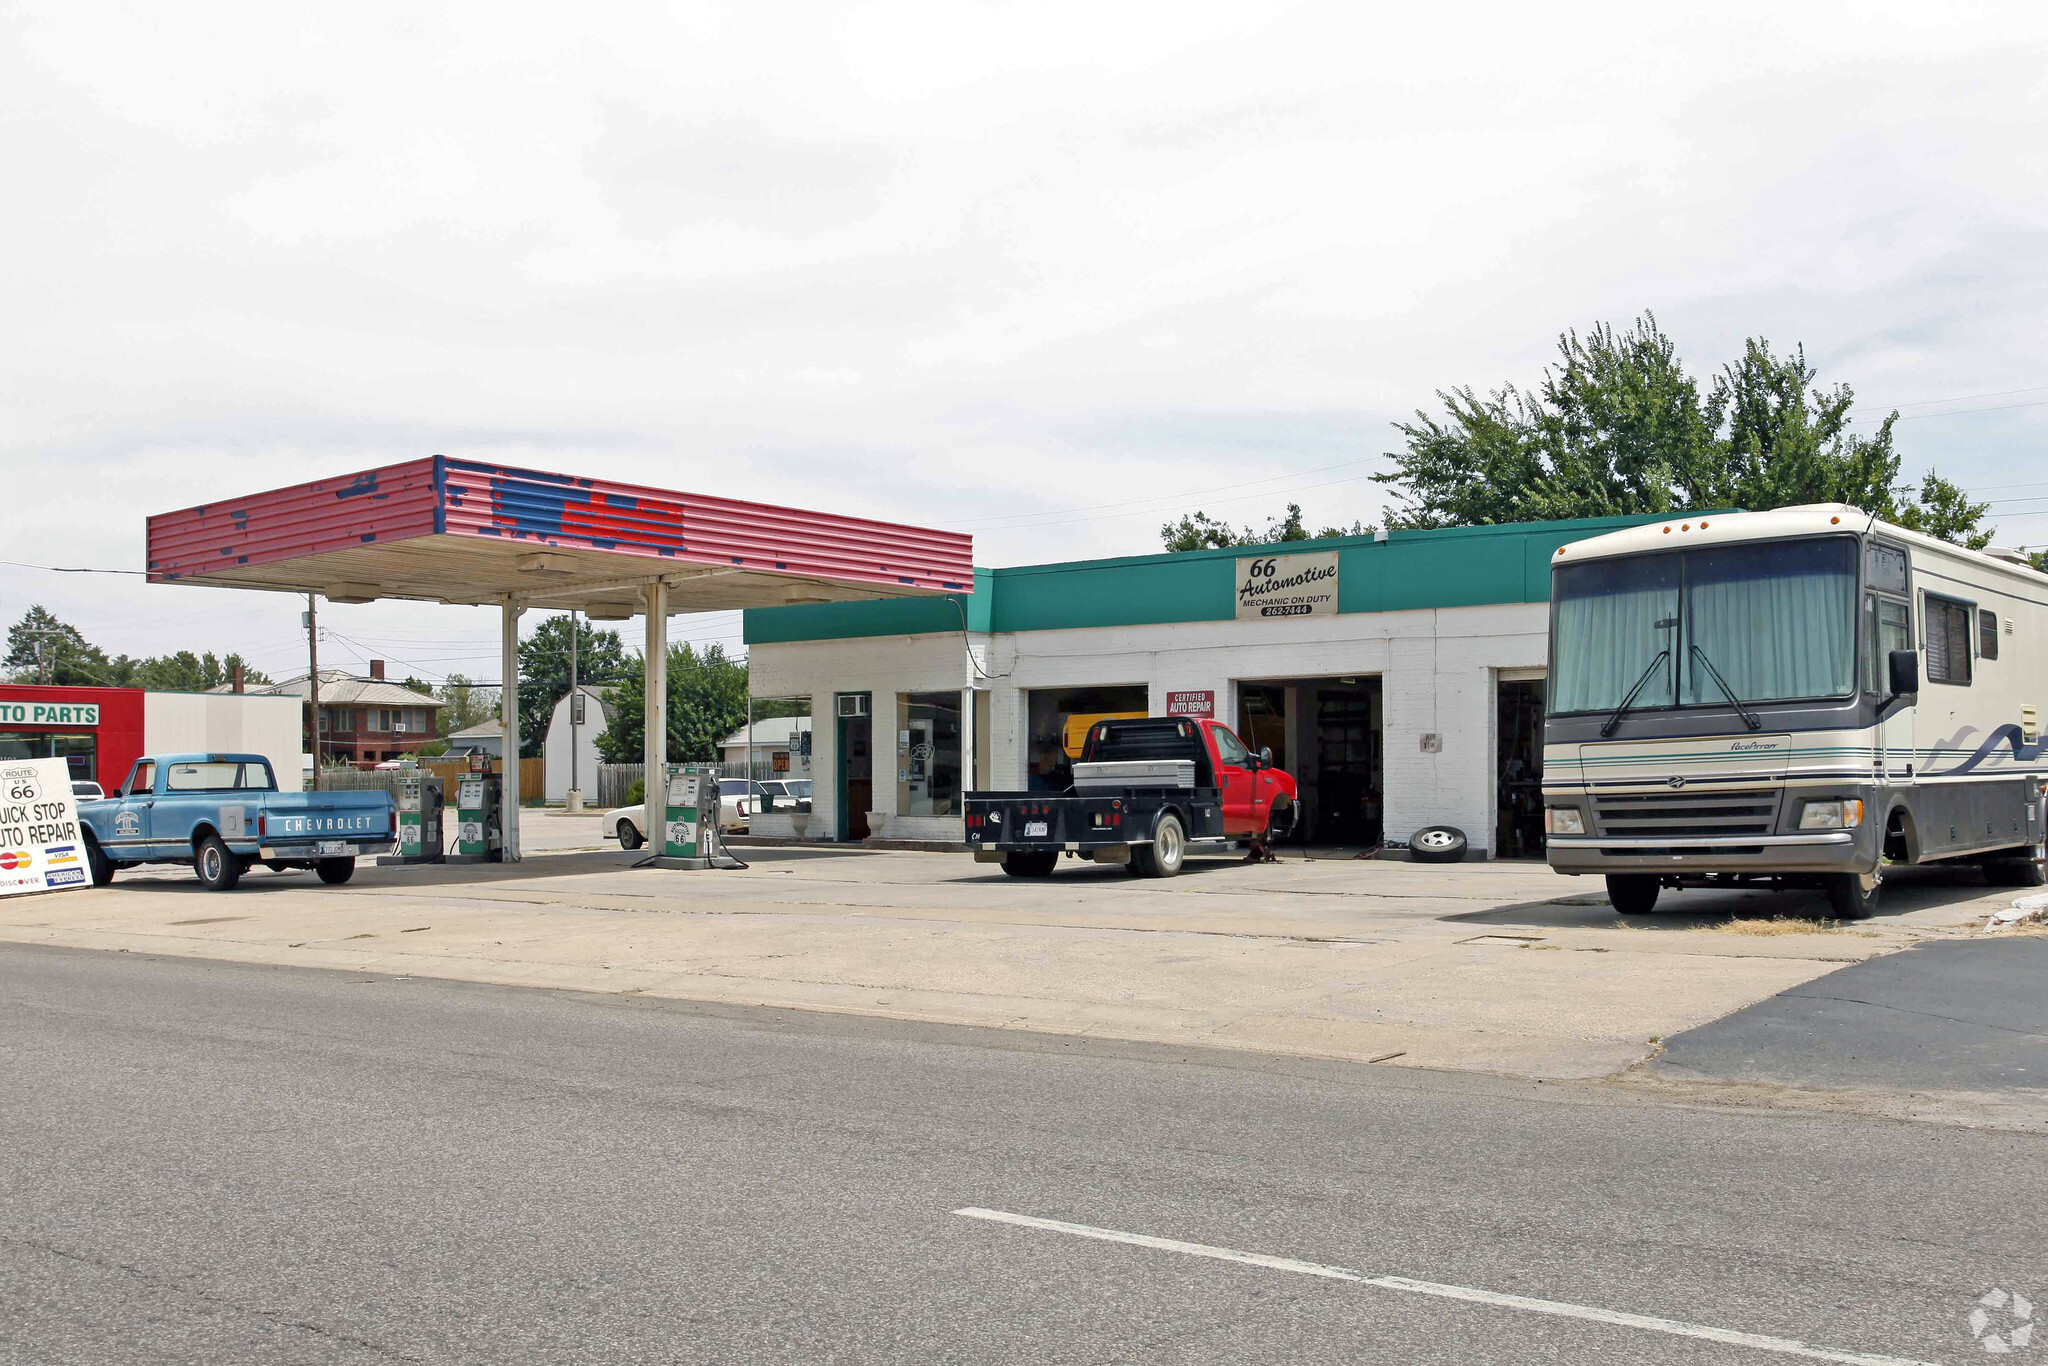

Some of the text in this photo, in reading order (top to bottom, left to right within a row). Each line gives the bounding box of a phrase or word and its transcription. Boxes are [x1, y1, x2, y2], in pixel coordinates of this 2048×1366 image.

[1250, 558, 1277, 578] 66
[1239, 565, 1337, 601] Automotive
[1242, 594, 1332, 608] MECHANIC ON DUTY
[1265, 604, 1308, 616] 262-7444
[1174, 692, 1206, 702] CERTIFIED
[1170, 701, 1211, 713] AUTO REPAIR
[33, 706, 97, 723] PARTS
[911, 746, 936, 758] OPEN
[773, 759, 790, 771] OPEN
[5, 769, 33, 778] ROUTE
[10, 785, 35, 800] 66
[33, 802, 66, 822] STOP
[285, 817, 371, 832] CHEVROLET
[28, 822, 77, 845] REPAIR
[675, 834, 685, 843] 66
[47, 870, 82, 880] AMERICAN
[54, 875, 84, 884] EXPRESS
